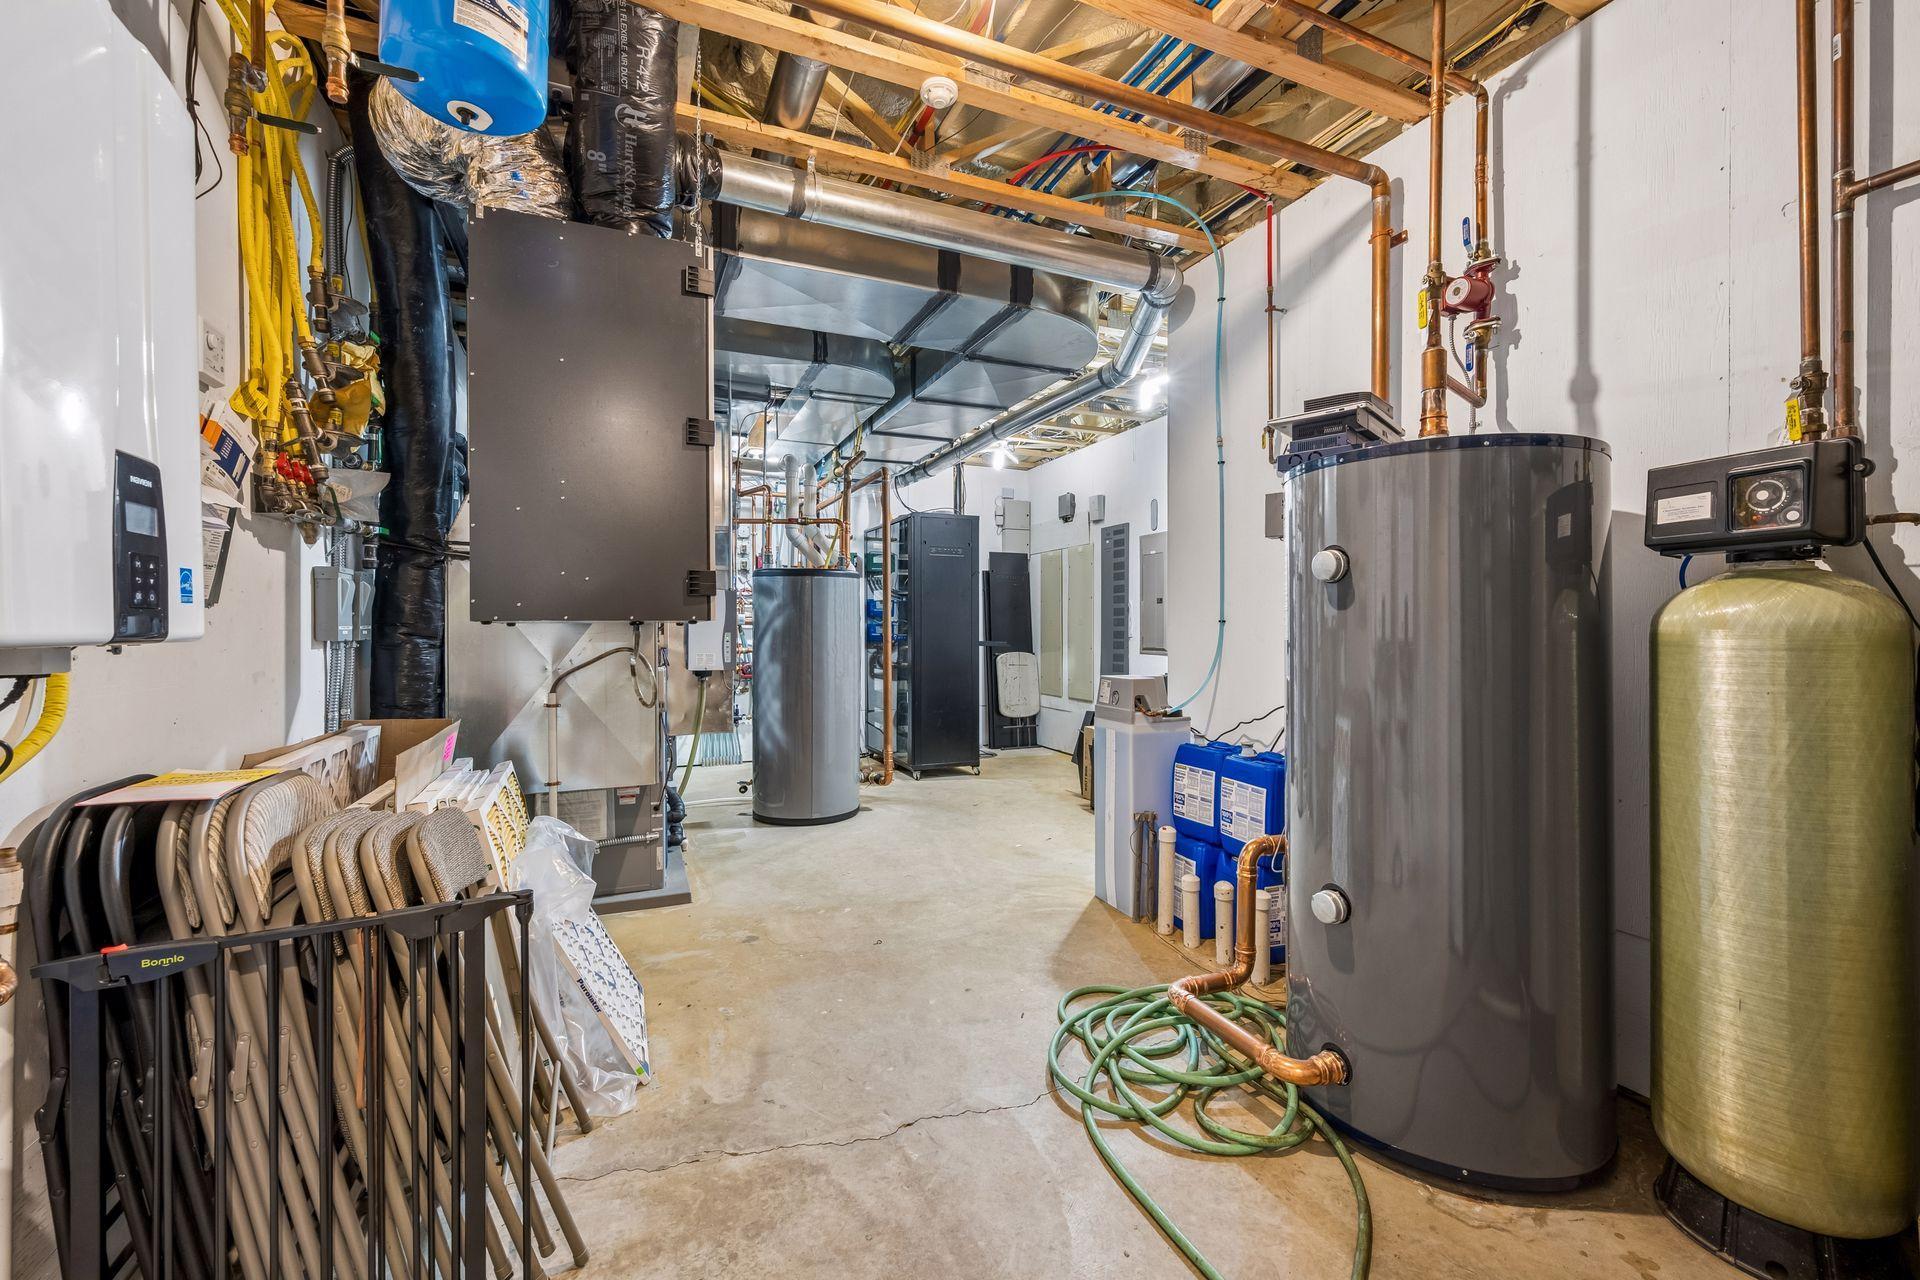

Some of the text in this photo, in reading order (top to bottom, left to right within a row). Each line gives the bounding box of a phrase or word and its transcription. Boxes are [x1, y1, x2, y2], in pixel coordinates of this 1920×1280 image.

[620, 13, 628, 51] FLEXIBLE
[620, 51, 628, 66] AIR
[635, 45, 651, 92] R-4.2
[620, 66, 629, 89] DUCT
[576, 978, 602, 1013] Purolator
